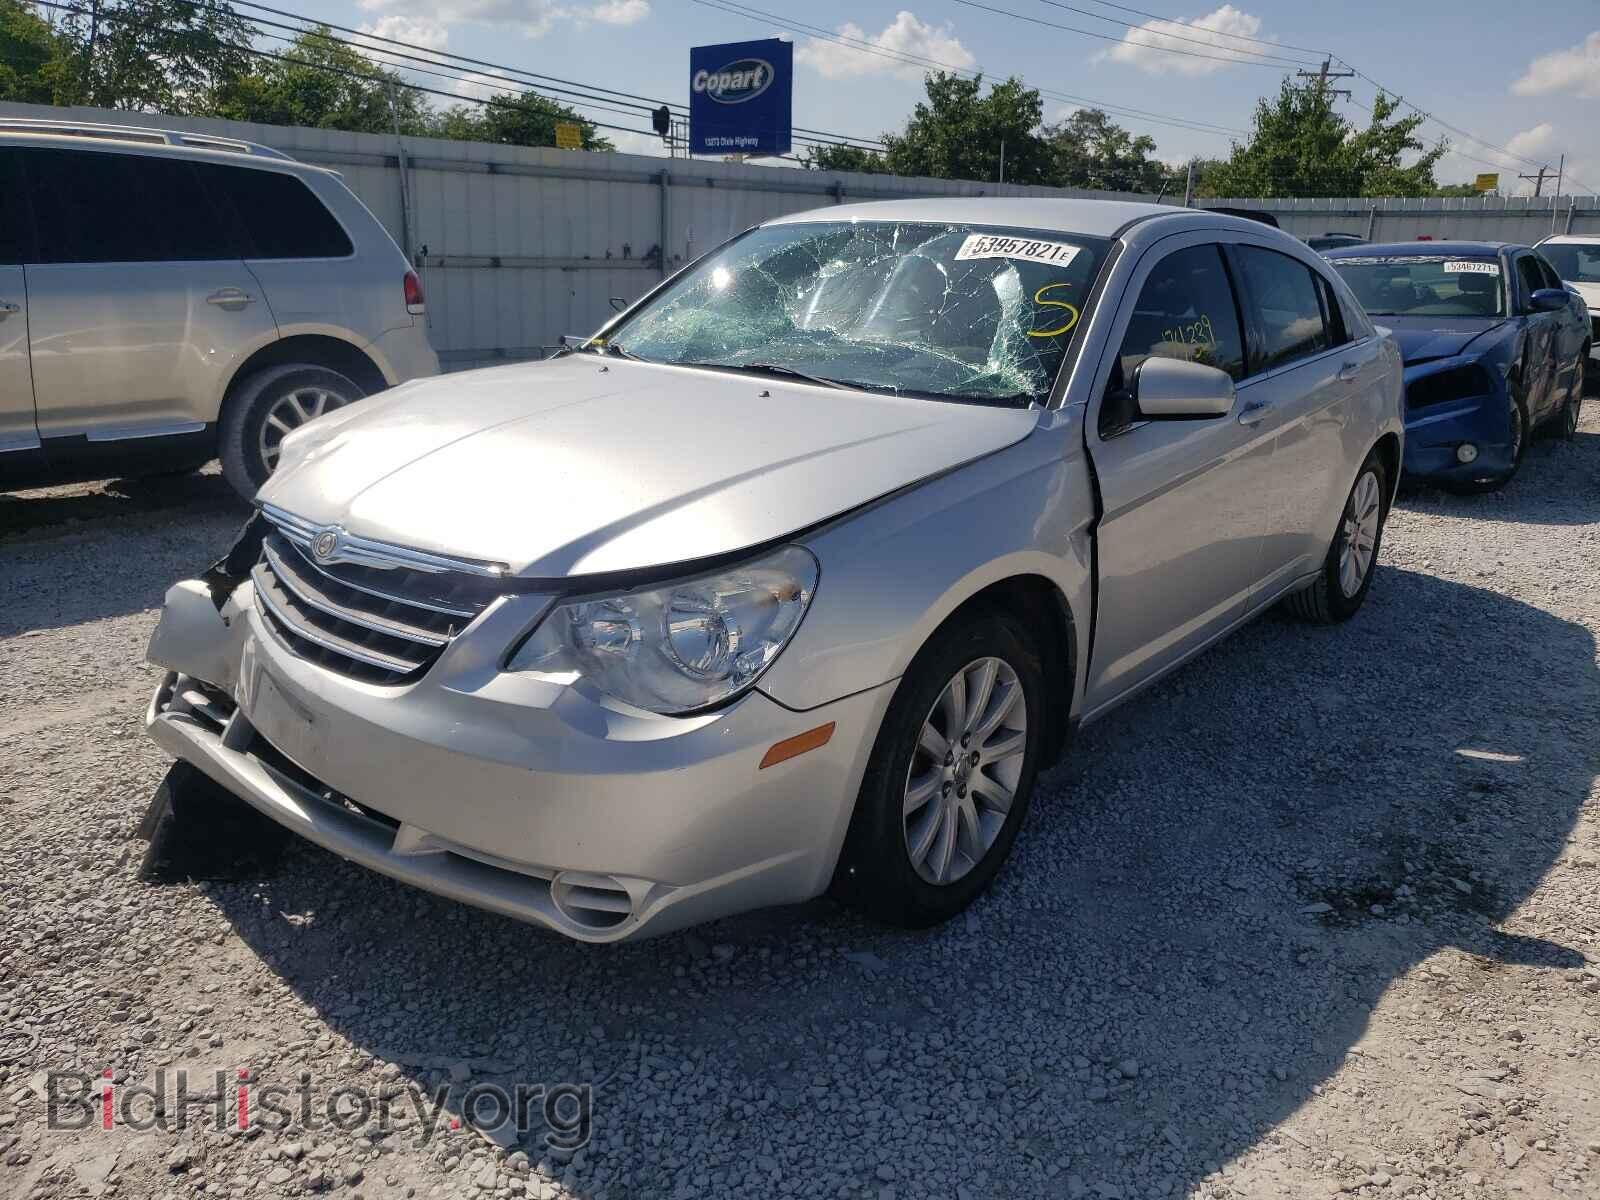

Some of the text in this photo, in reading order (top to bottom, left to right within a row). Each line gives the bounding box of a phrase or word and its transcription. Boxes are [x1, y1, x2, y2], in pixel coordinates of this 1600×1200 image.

[693, 65, 765, 97] Copart
[734, 136, 759, 148] Highway
[972, 236, 1062, 260] 53957821
[1026, 282, 1079, 337] S
